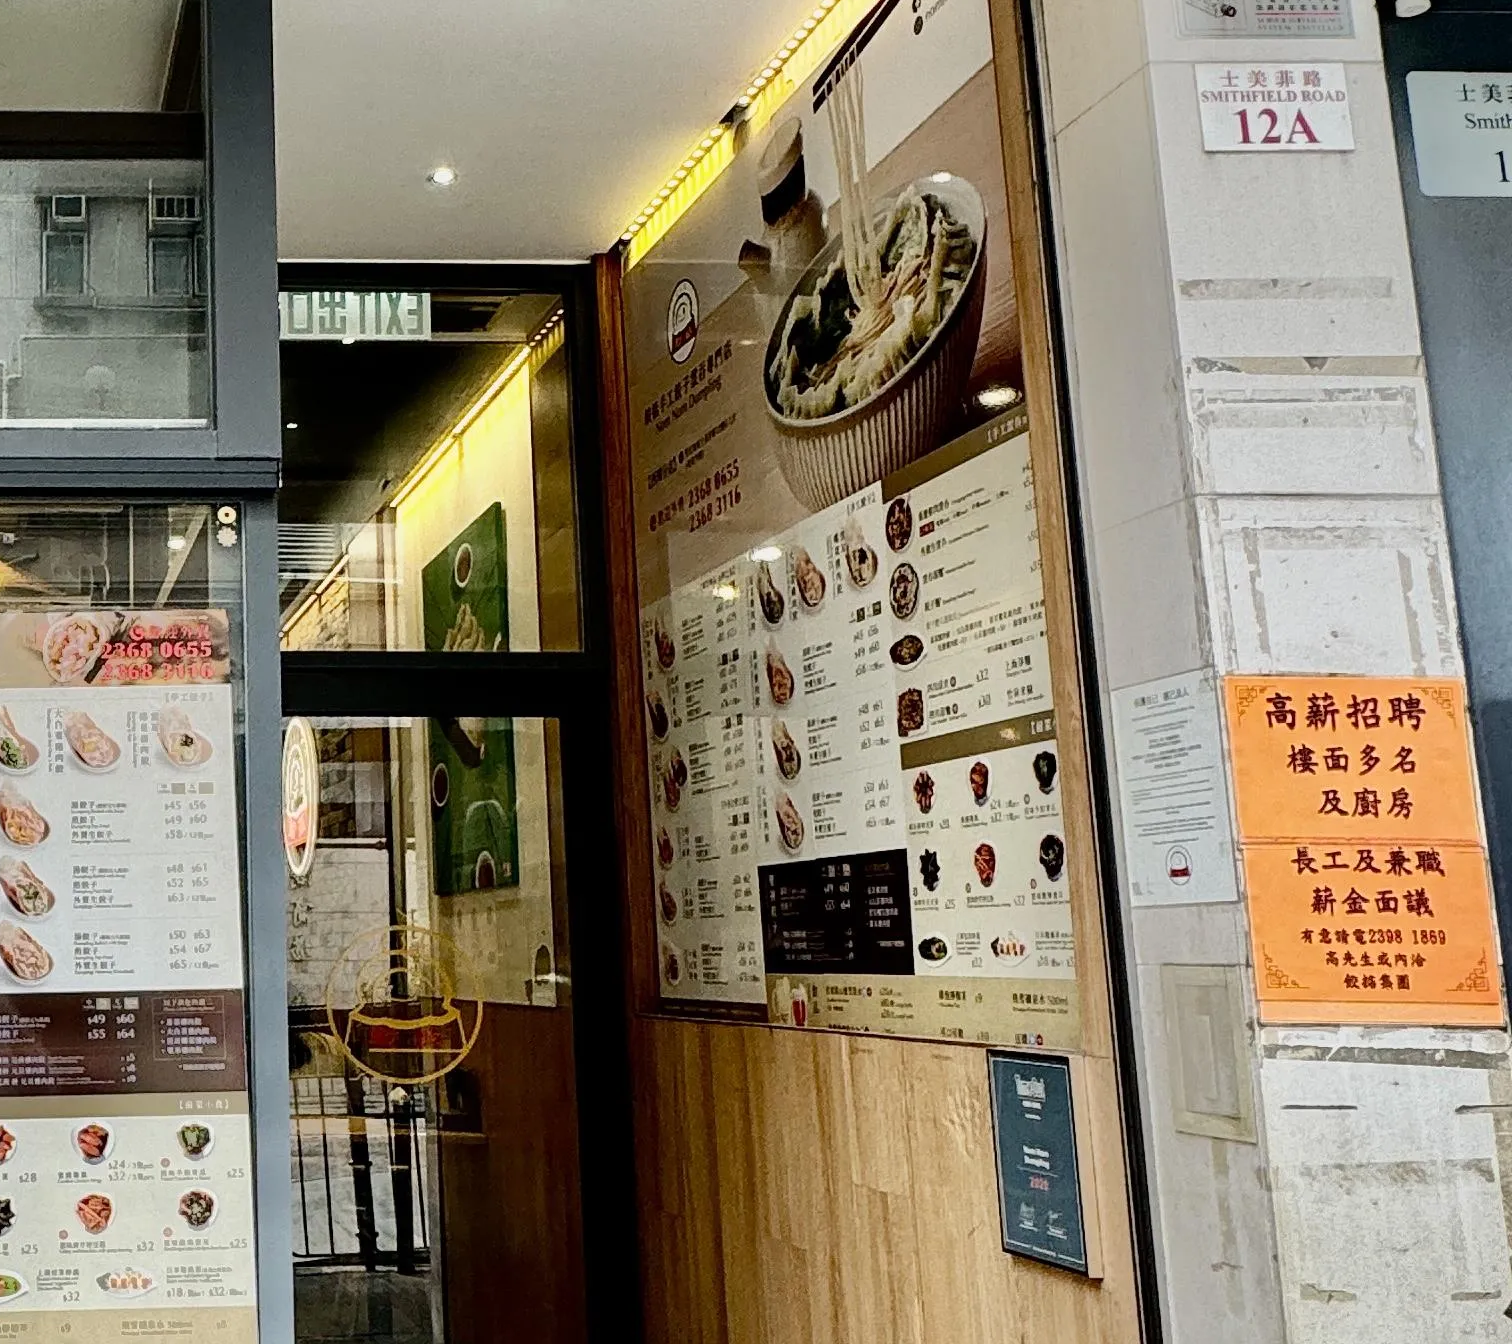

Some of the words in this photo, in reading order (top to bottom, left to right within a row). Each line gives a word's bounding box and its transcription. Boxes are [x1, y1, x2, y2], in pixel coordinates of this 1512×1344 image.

[1220, 70, 1321, 87] 士美菲路
[1201, 90, 1297, 102] SMITHFIELD
[1301, 90, 1345, 102] ROAD
[1455, 84, 1512, 103] 士美
[1233, 108, 1322, 144] 12A
[688, 479, 712, 508] 2368
[714, 459, 739, 490] 0655
[689, 503, 713, 533] 2368
[716, 485, 741, 516] 3116
[102, 643, 152, 658] 2368
[159, 642, 212, 658] 0655
[101, 664, 152, 680] 2368
[163, 663, 214, 679] 3116
[1266, 692, 1426, 731] 高薪招聘
[1287, 744, 1417, 775] 樓面多名
[1319, 788, 1414, 819] 及廚房
[1291, 847, 1445, 876] 長工及兼職
[1312, 888, 1434, 917] 薪金面議
[1413, 928, 1447, 945] 1869
[169, 944, 186, 954] $54
[87, 1014, 106, 1025] $49
[116, 1013, 135, 1024] $60
[88, 1028, 106, 1040] $55
[117, 1028, 136, 1039] $64
[108, 1159, 126, 1170] $24
[19, 1172, 37, 1183] $28
[108, 1171, 127, 1182] $32
[227, 1168, 245, 1178] $25
[21, 1244, 39, 1255] $25
[136, 1241, 155, 1252] $32
[229, 1239, 248, 1249] $25
[62, 1291, 80, 1302] $32
[166, 1287, 184, 1298] $18
